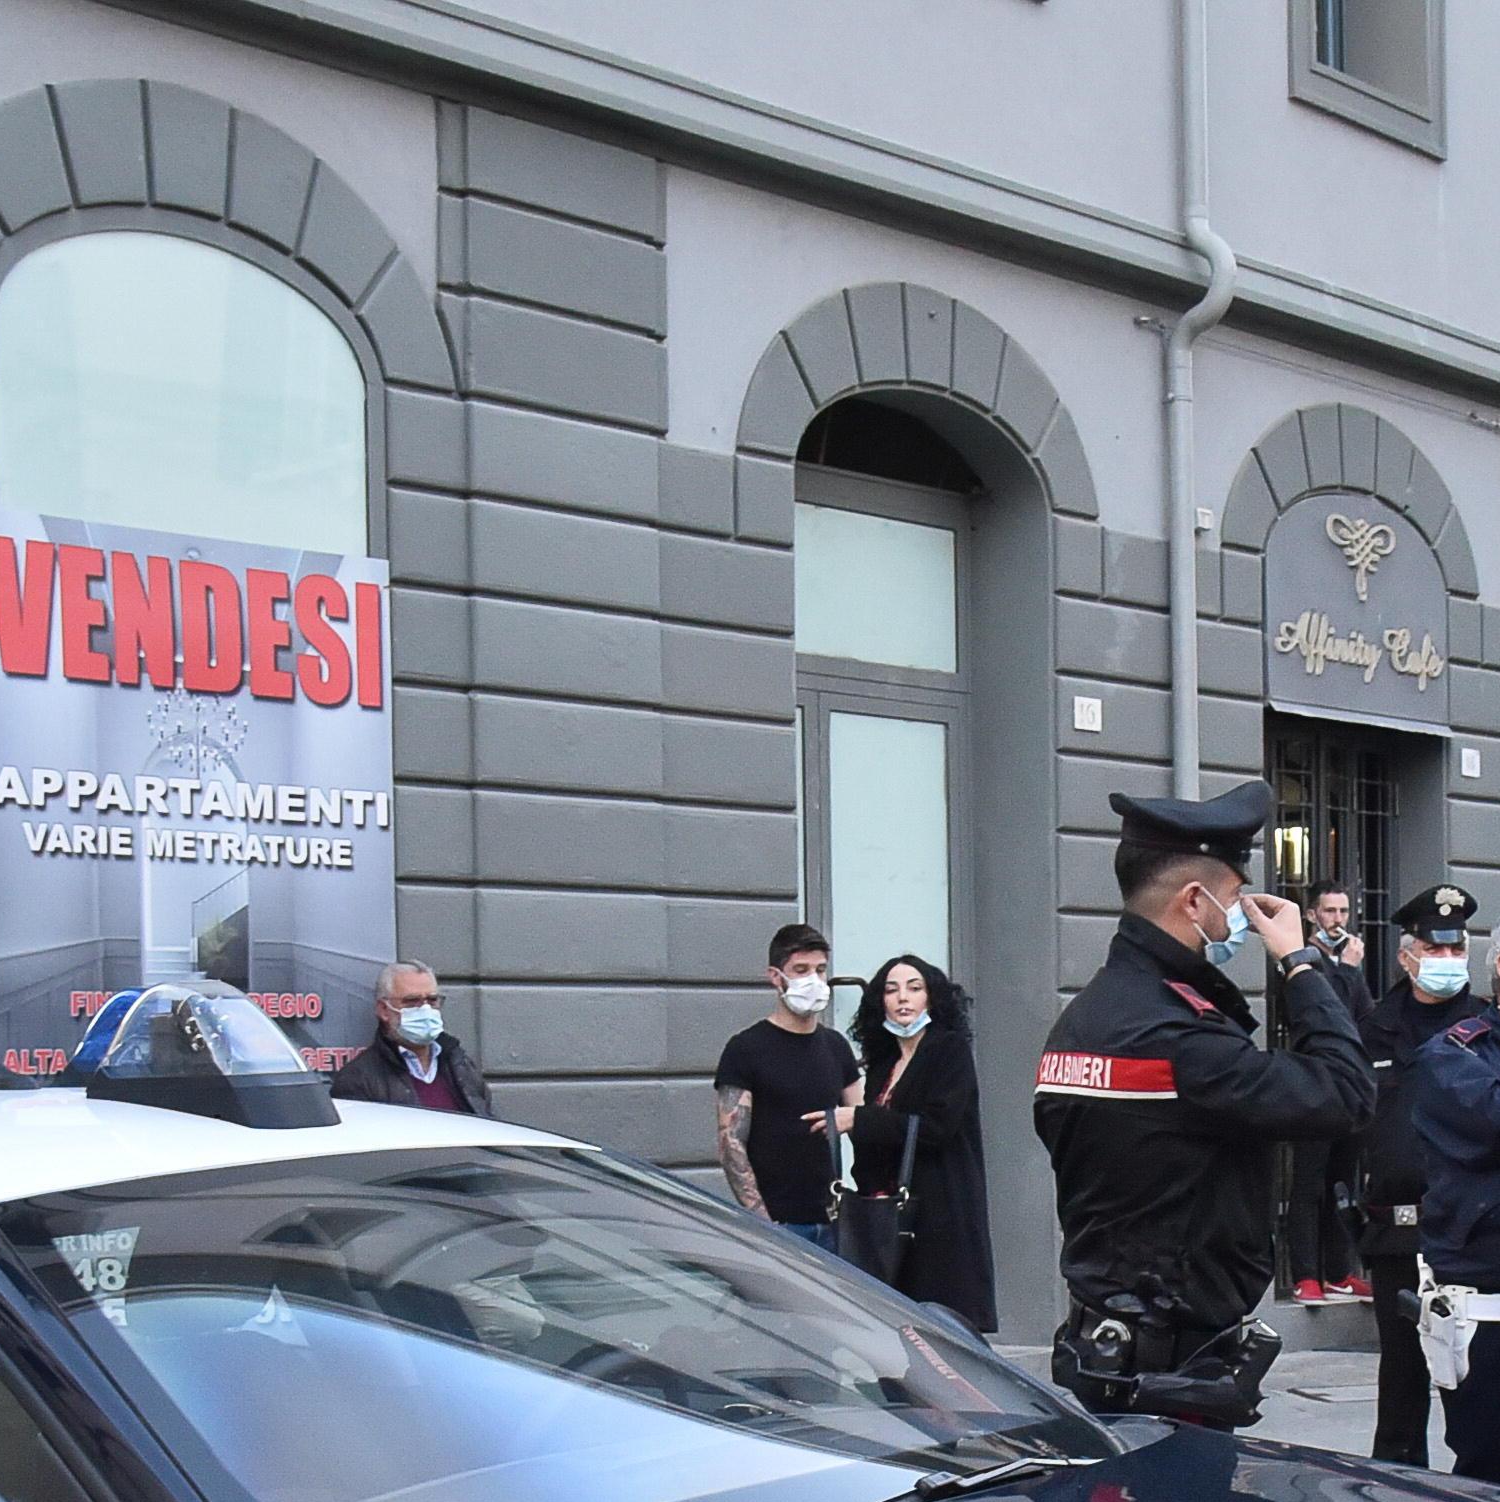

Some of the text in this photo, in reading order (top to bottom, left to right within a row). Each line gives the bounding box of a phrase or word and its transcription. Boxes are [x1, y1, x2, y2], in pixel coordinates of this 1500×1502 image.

[1275, 611, 1382, 683] Affinity
[23, 822, 353, 867] VARIE METRATURE
[4, 1049, 68, 1075] ALTA
[1040, 1054, 1112, 1088] CARABINIERI
[81, 1231, 134, 1252] INFO
